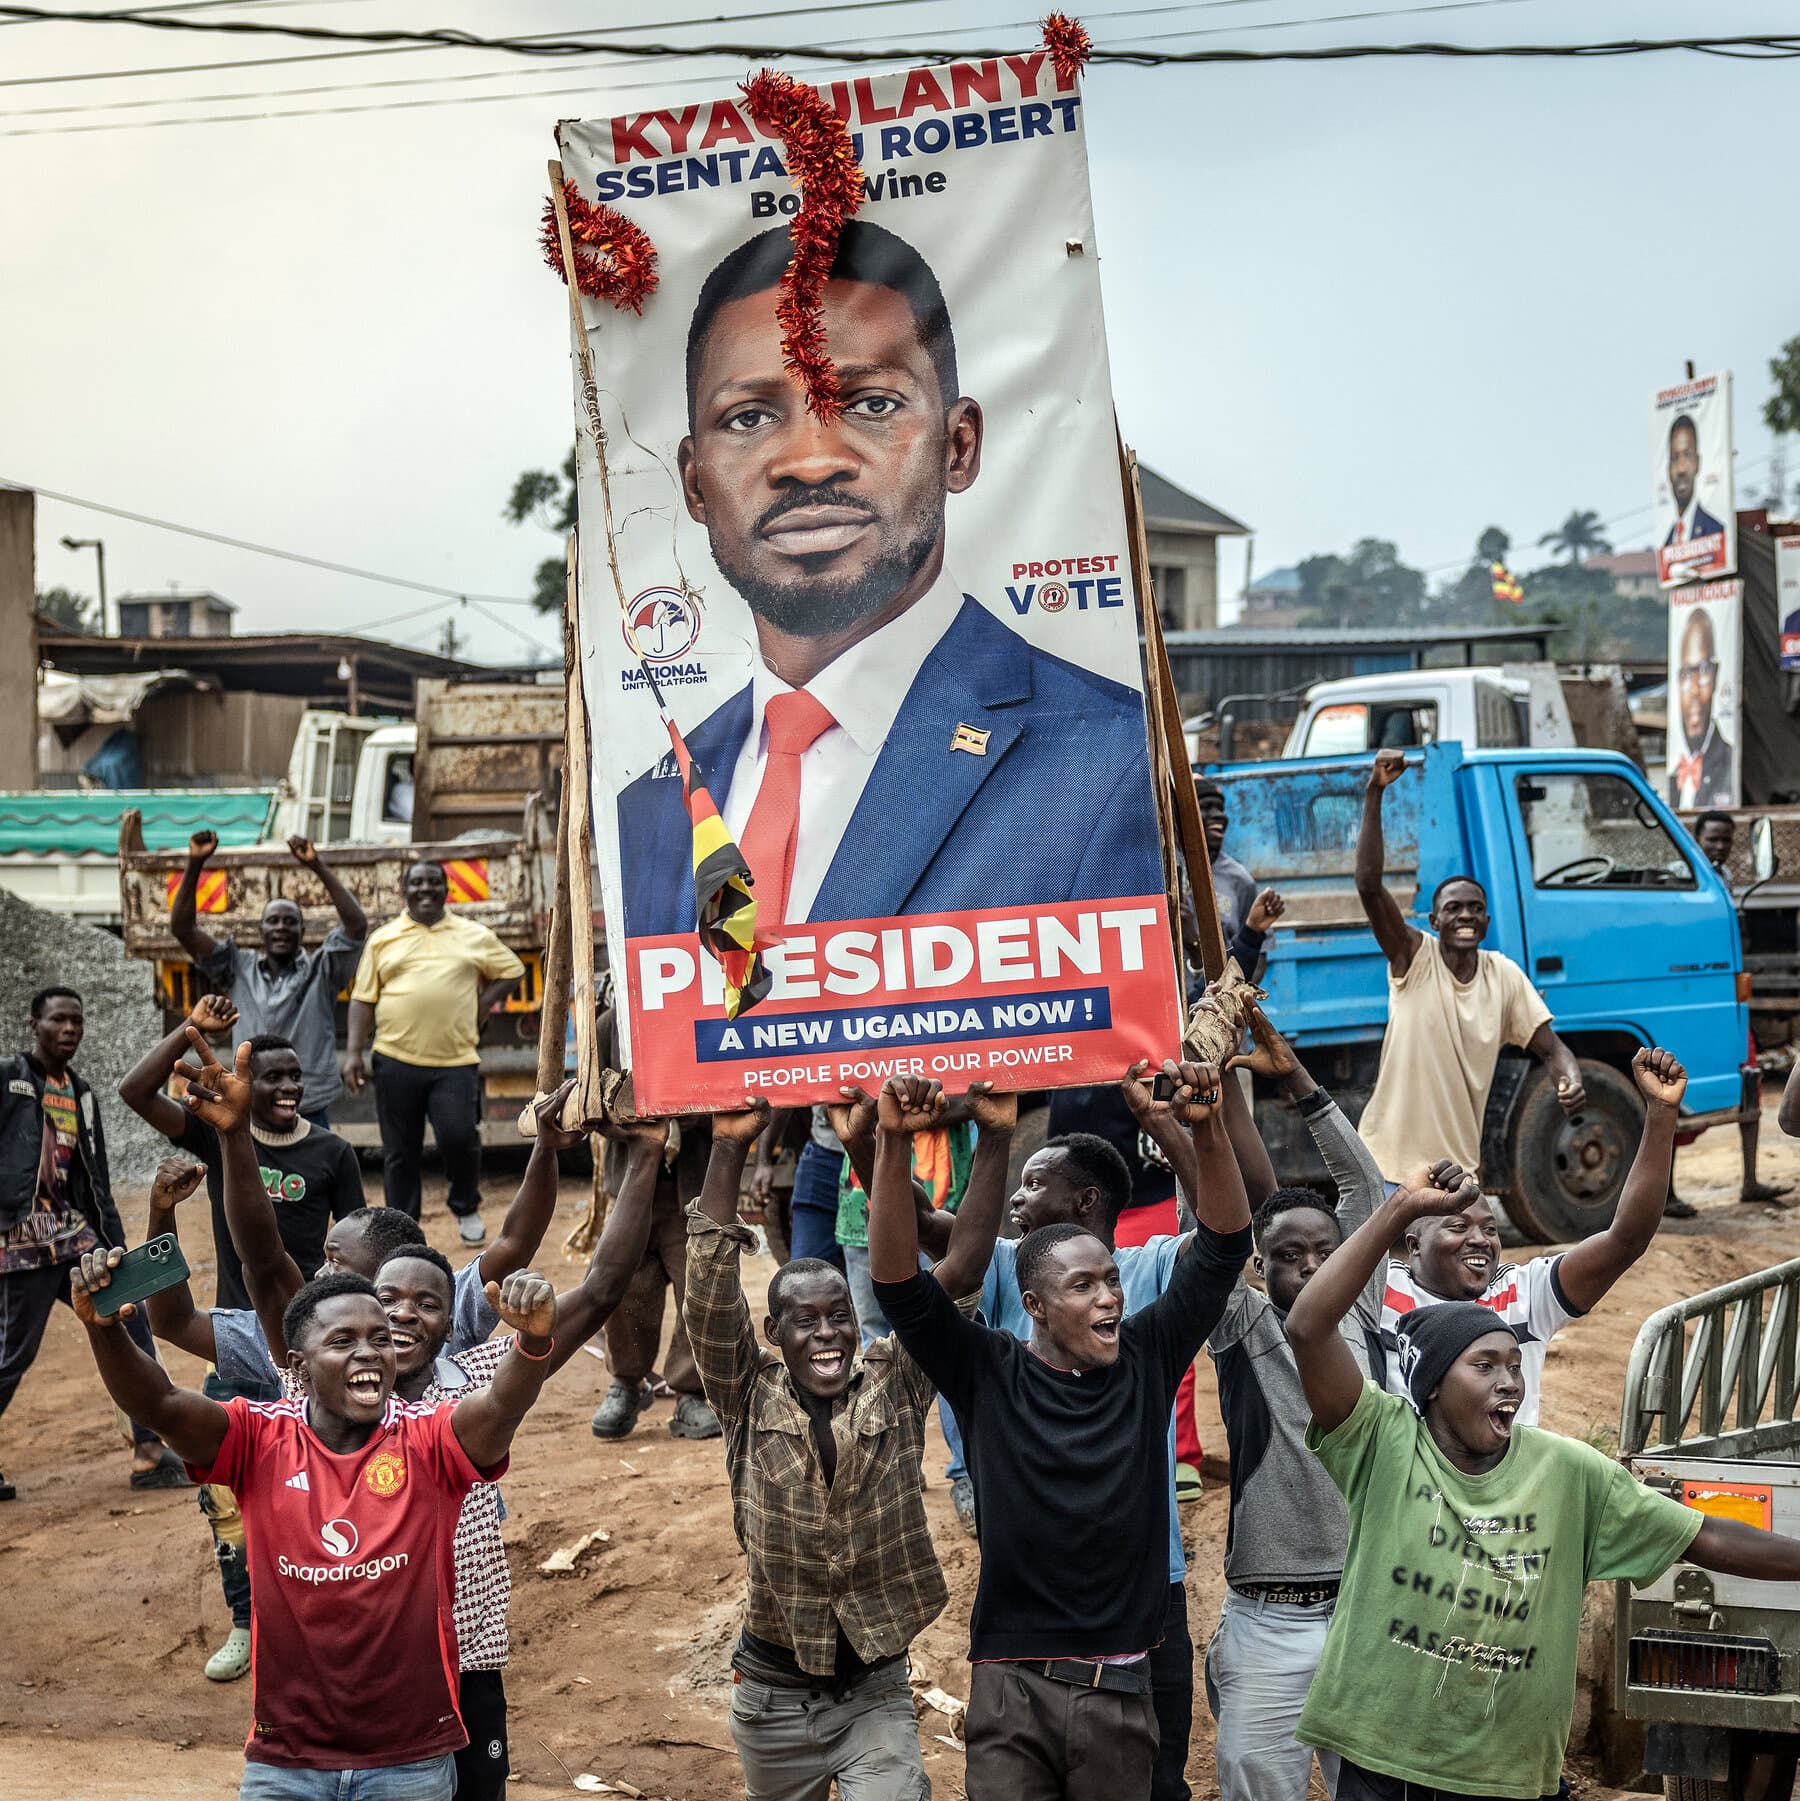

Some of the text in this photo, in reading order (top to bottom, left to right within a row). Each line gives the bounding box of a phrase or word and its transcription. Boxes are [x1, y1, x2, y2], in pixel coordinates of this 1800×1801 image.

[596, 97, 1081, 202] SSENTA ROBERT
[1012, 555, 1119, 580] PROTEST
[622, 675, 708, 691] UNITY PLATFORM
[719, 1027, 744, 1051] A
[753, 1019, 834, 1049] NEW
[842, 1007, 985, 1042] UGANDA
[992, 999, 1075, 1029] NOW
[743, 1044, 1074, 1088] PEOPLE POWER OUR POWER
[278, 1552, 409, 1586] Snapdragon
